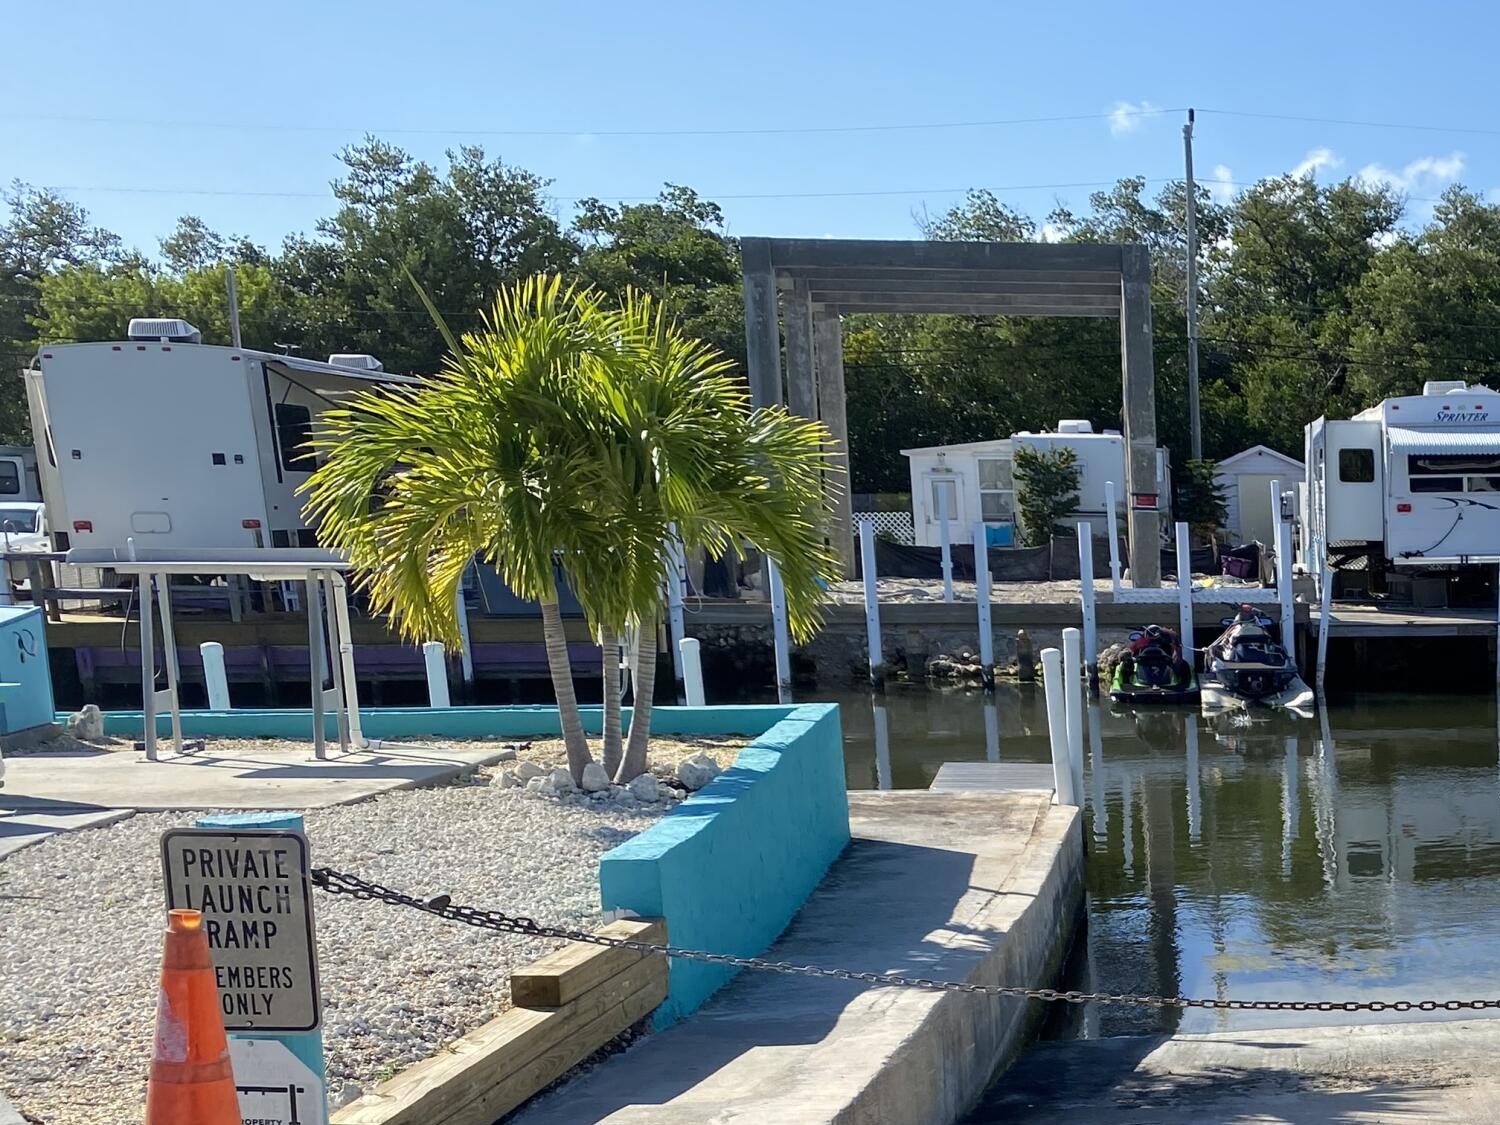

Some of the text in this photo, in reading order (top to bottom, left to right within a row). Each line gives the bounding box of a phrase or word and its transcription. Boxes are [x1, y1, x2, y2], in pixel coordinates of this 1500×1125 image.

[182, 848, 289, 879] PRIVATE
[185, 884, 291, 914] LAUNCH
[207, 920, 277, 949] RAMP
[215, 966, 293, 988] EMBERS
[223, 993, 273, 1015] ONLY
[241, 1118, 282, 1125] ROPERTY
